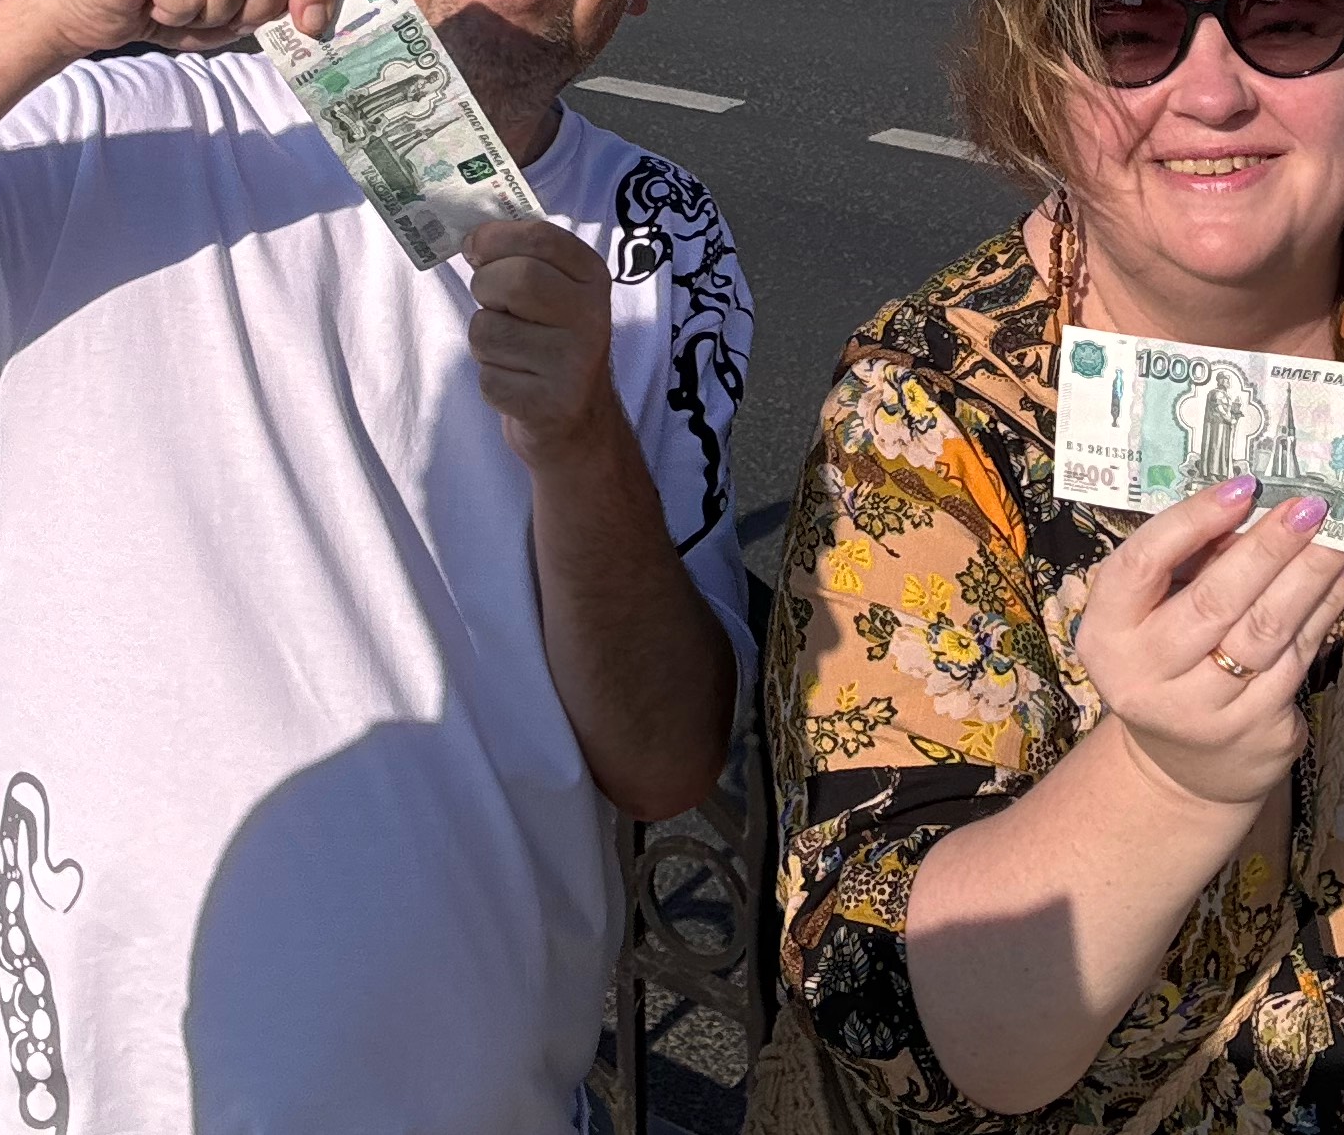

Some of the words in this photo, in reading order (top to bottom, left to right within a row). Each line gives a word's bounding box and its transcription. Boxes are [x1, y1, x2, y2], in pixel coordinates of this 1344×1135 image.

[392, 11, 440, 70] 1000
[1136, 349, 1212, 387] 1000
[1270, 366, 1321, 382] БИЛЕТ
[1064, 461, 1113, 487] 1000
